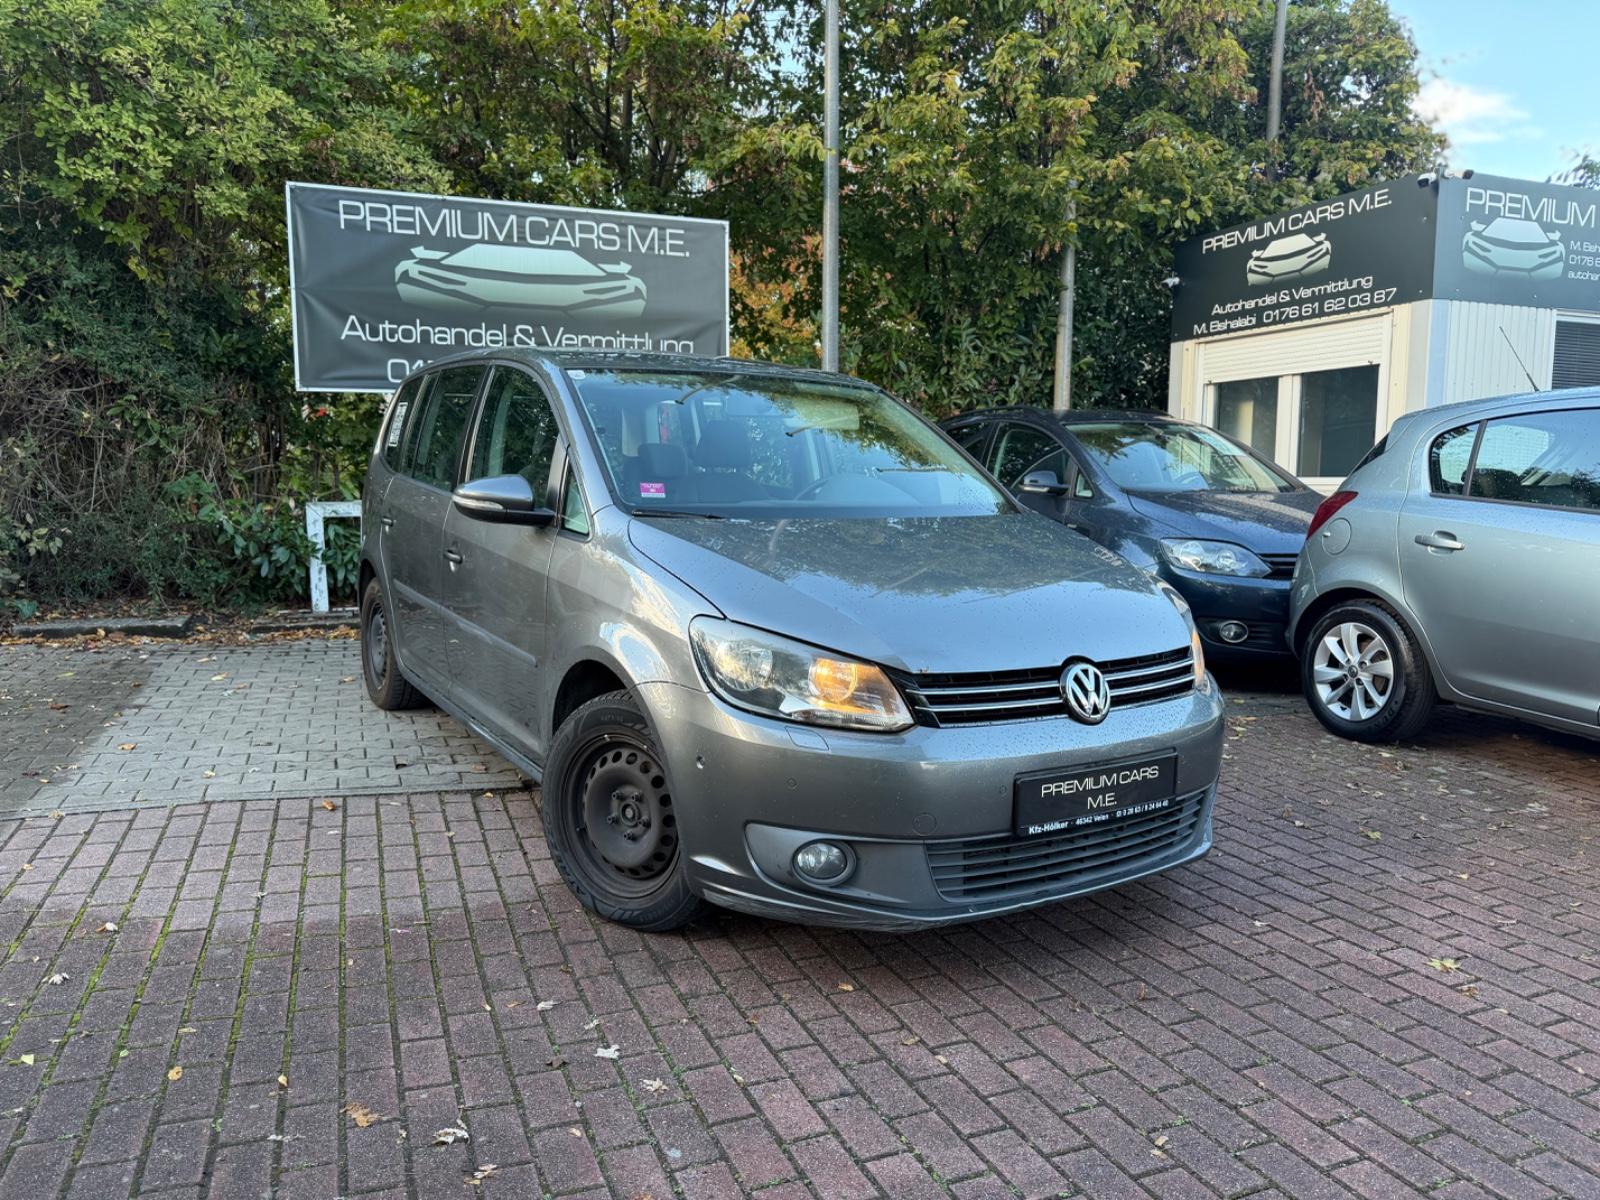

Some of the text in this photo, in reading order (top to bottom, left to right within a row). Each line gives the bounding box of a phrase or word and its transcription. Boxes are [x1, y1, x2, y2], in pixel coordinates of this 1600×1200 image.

[1202, 188, 1392, 254] PREMIUM CARS M.E.
[1466, 187, 1597, 228] PREMIUM
[338, 200, 690, 257] PREMIUM CARS M.E.
[1569, 254, 1594, 267] 0176
[1193, 322, 1208, 335] M.
[1263, 305, 1300, 323] 0176
[1301, 301, 1319, 316] 61
[1323, 297, 1346, 313] 62
[1348, 292, 1371, 308] 03
[1373, 287, 1397, 304] 87
[1211, 276, 1373, 316] Autohandel & Vermittlung
[340, 314, 694, 354] Autohandel & Vermittlung
[1041, 765, 1160, 798] PREMIUM CARS
[1087, 792, 1118, 810] M.E.
